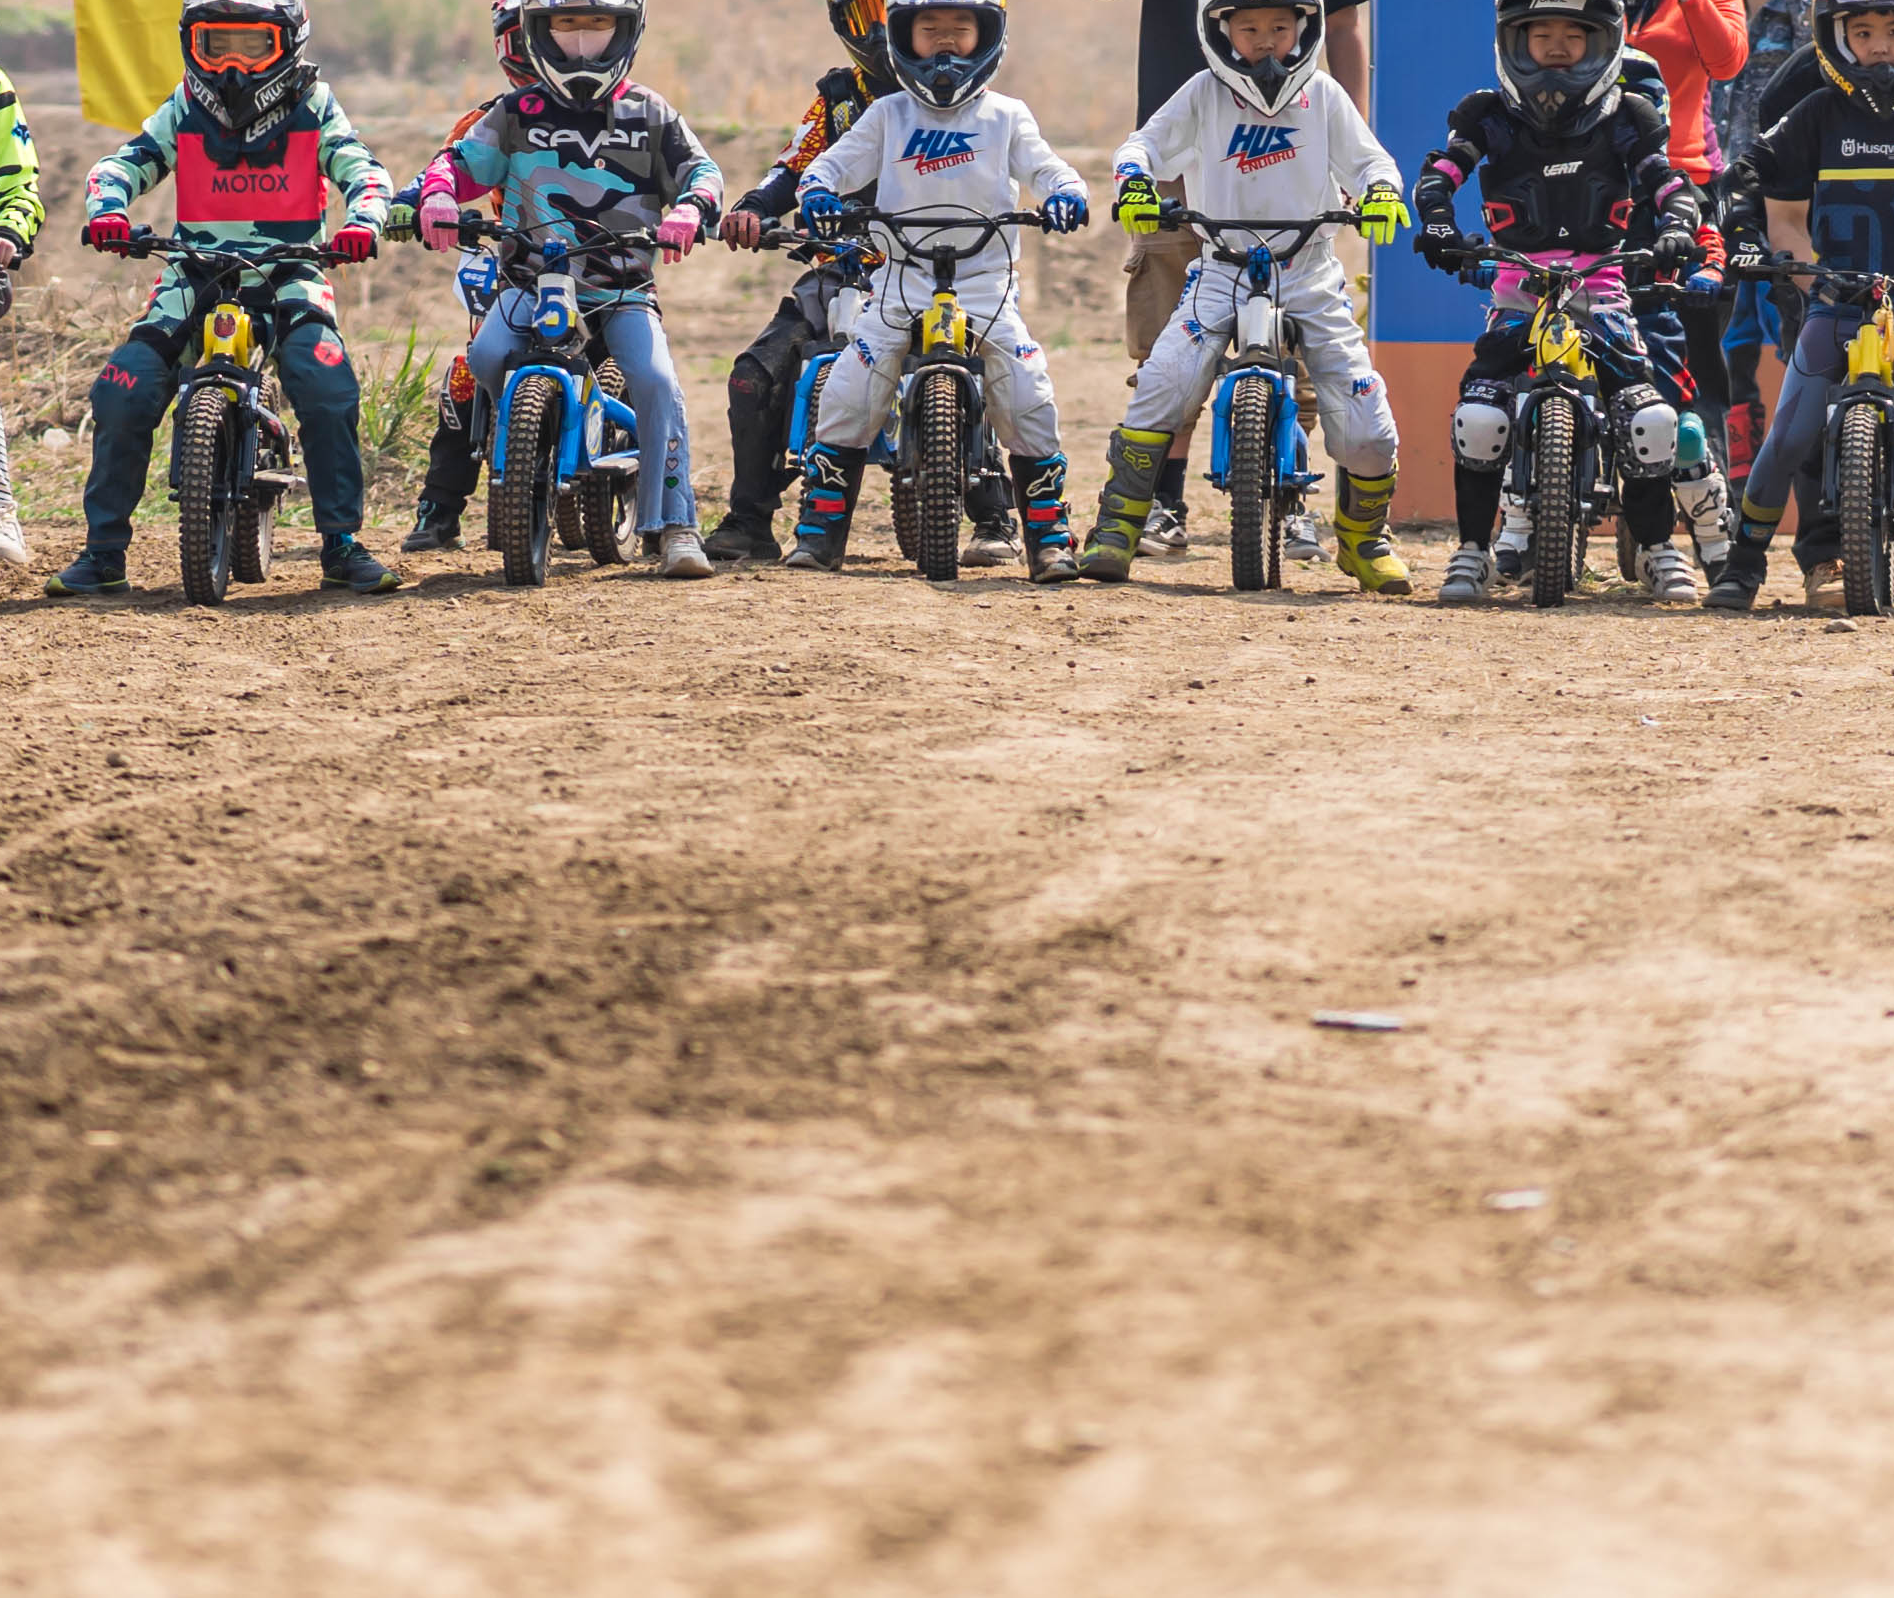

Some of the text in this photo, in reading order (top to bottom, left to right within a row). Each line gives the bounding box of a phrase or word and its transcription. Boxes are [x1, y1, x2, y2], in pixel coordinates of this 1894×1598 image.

[901, 127, 980, 161] HUS
[1226, 123, 1301, 159] HUS
[917, 152, 976, 176] ENDURO
[1240, 148, 1297, 175] ENDURO
[1543, 160, 1583, 177] LEATT
[211, 174, 290, 193] MOTOX
[1120, 192, 1152, 204] FOX
[1730, 254, 1764, 267] FOX
[537, 286, 570, 338] 5
